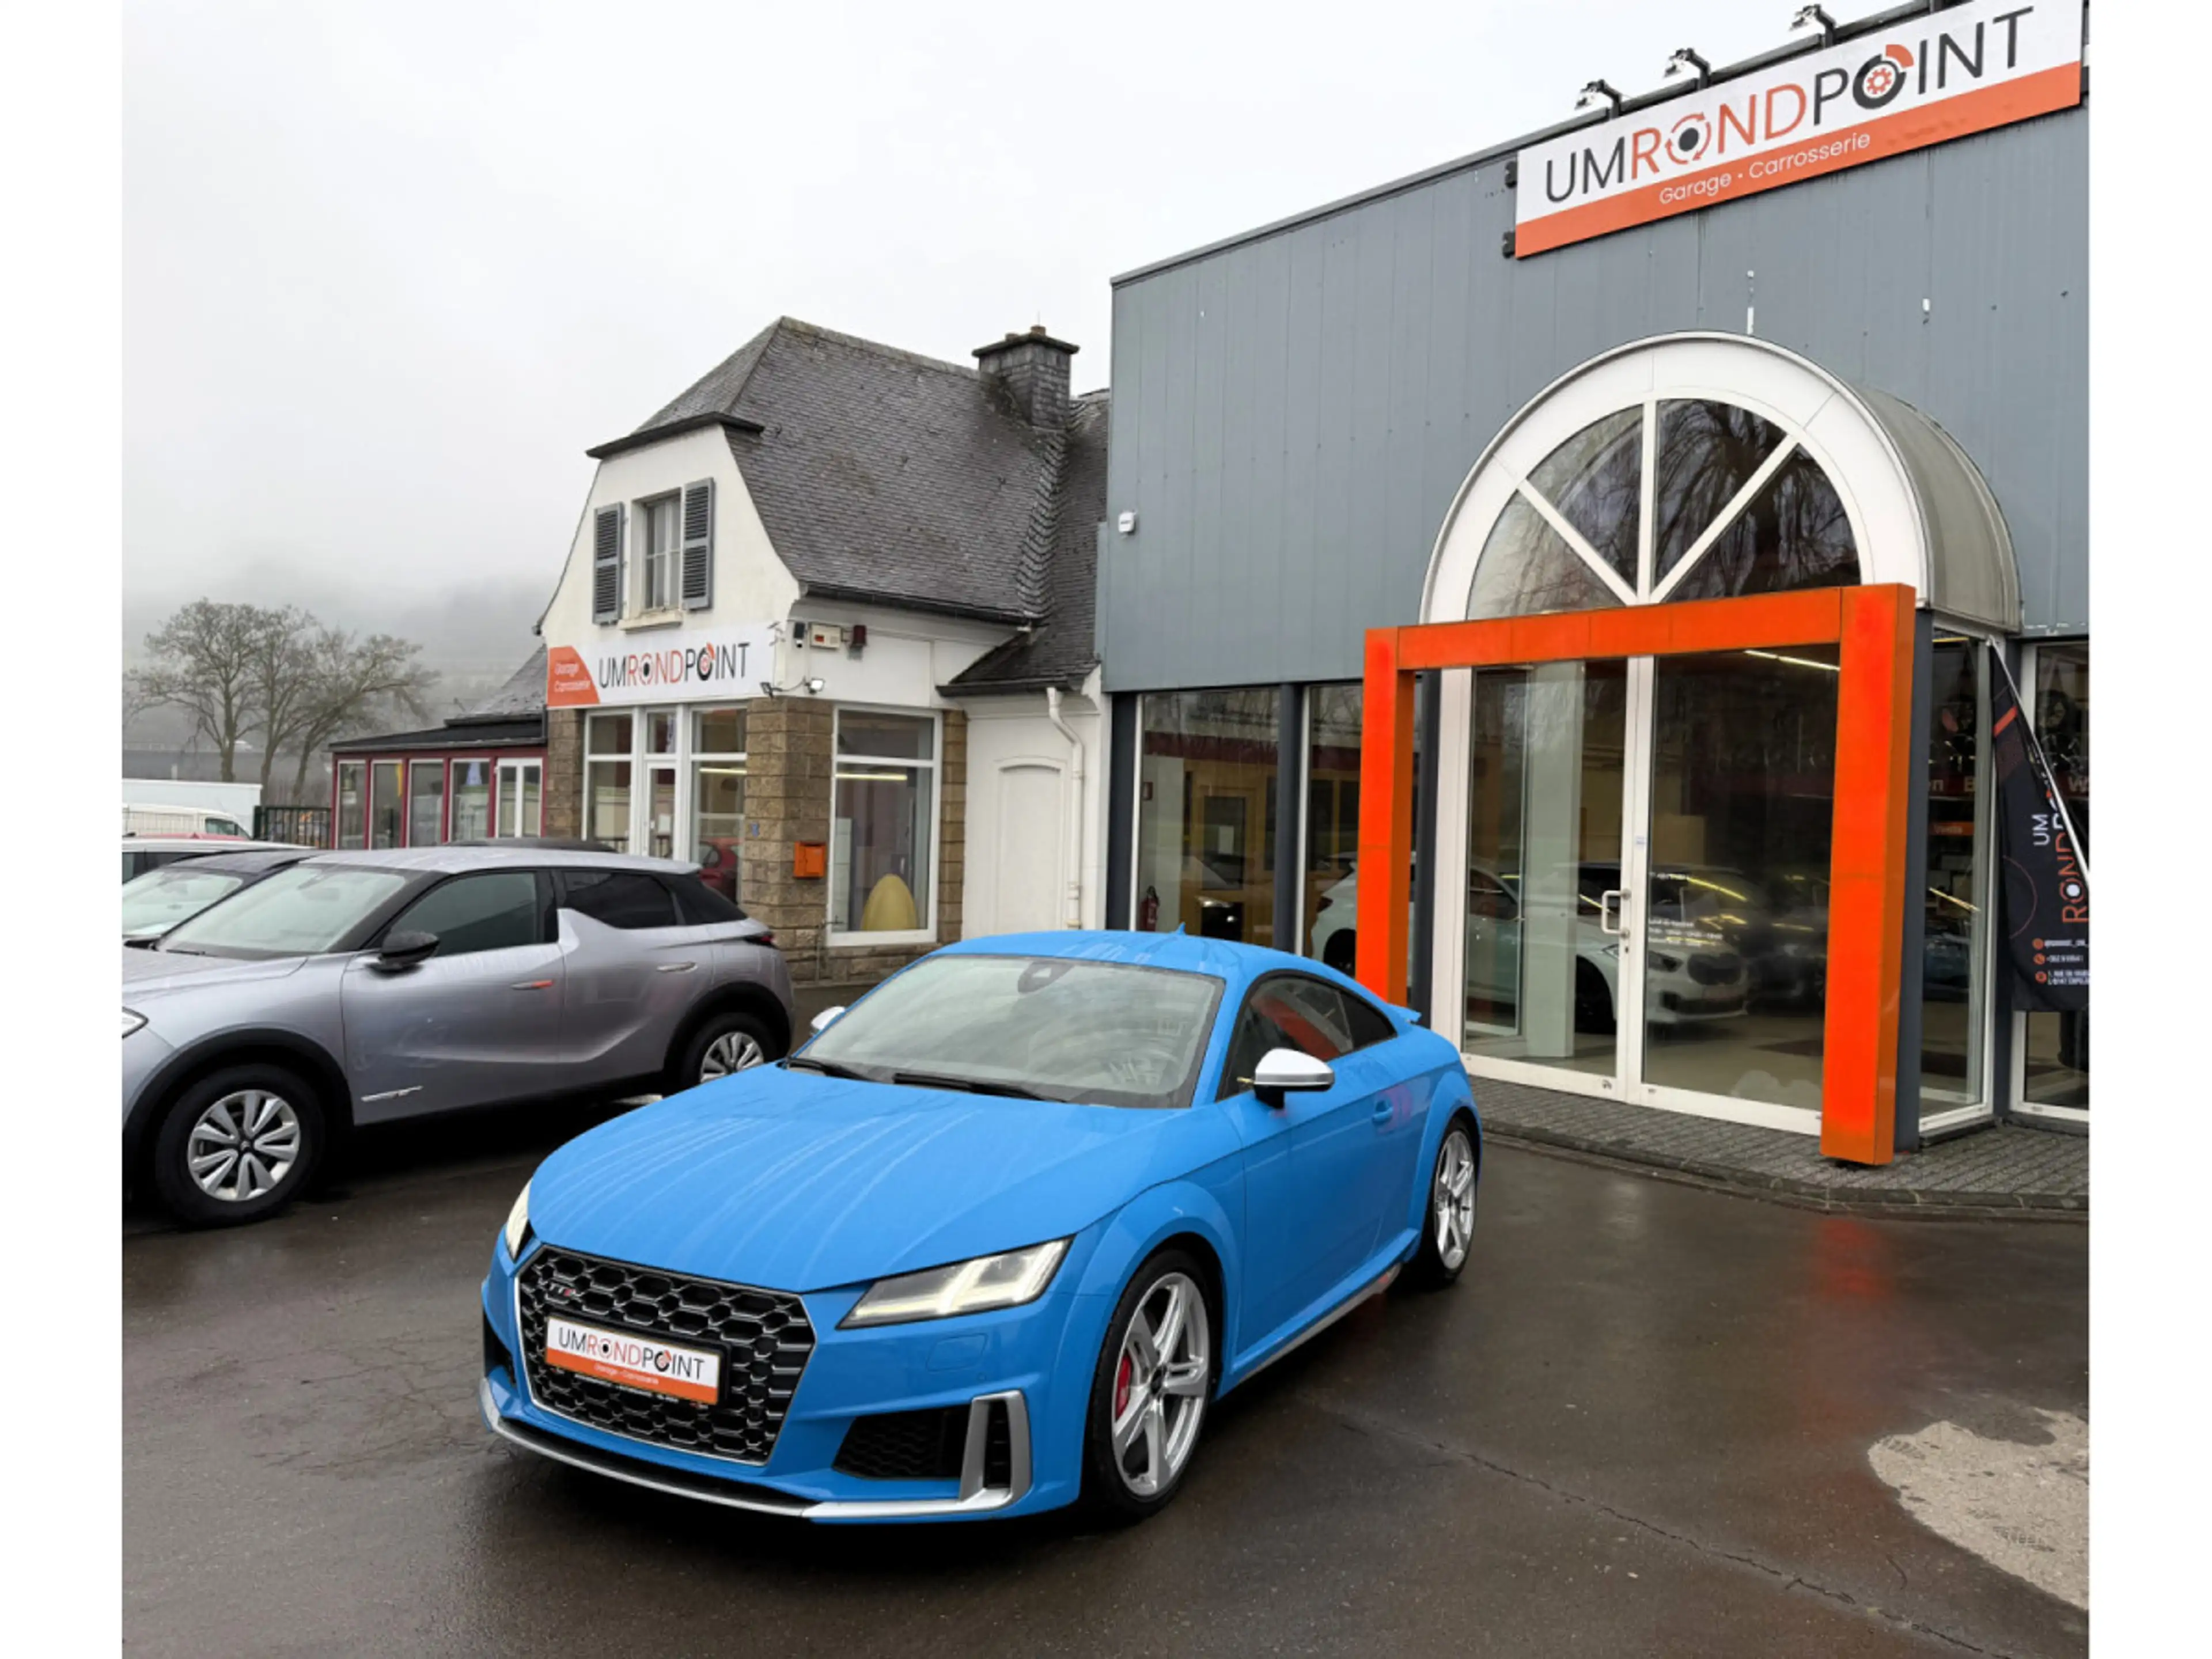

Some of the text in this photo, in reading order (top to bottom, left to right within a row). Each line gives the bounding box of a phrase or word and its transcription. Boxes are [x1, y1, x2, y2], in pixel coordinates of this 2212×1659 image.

[1658, 132, 1872, 204] Garage Carrosserie
[2031, 813, 2051, 846] UM
